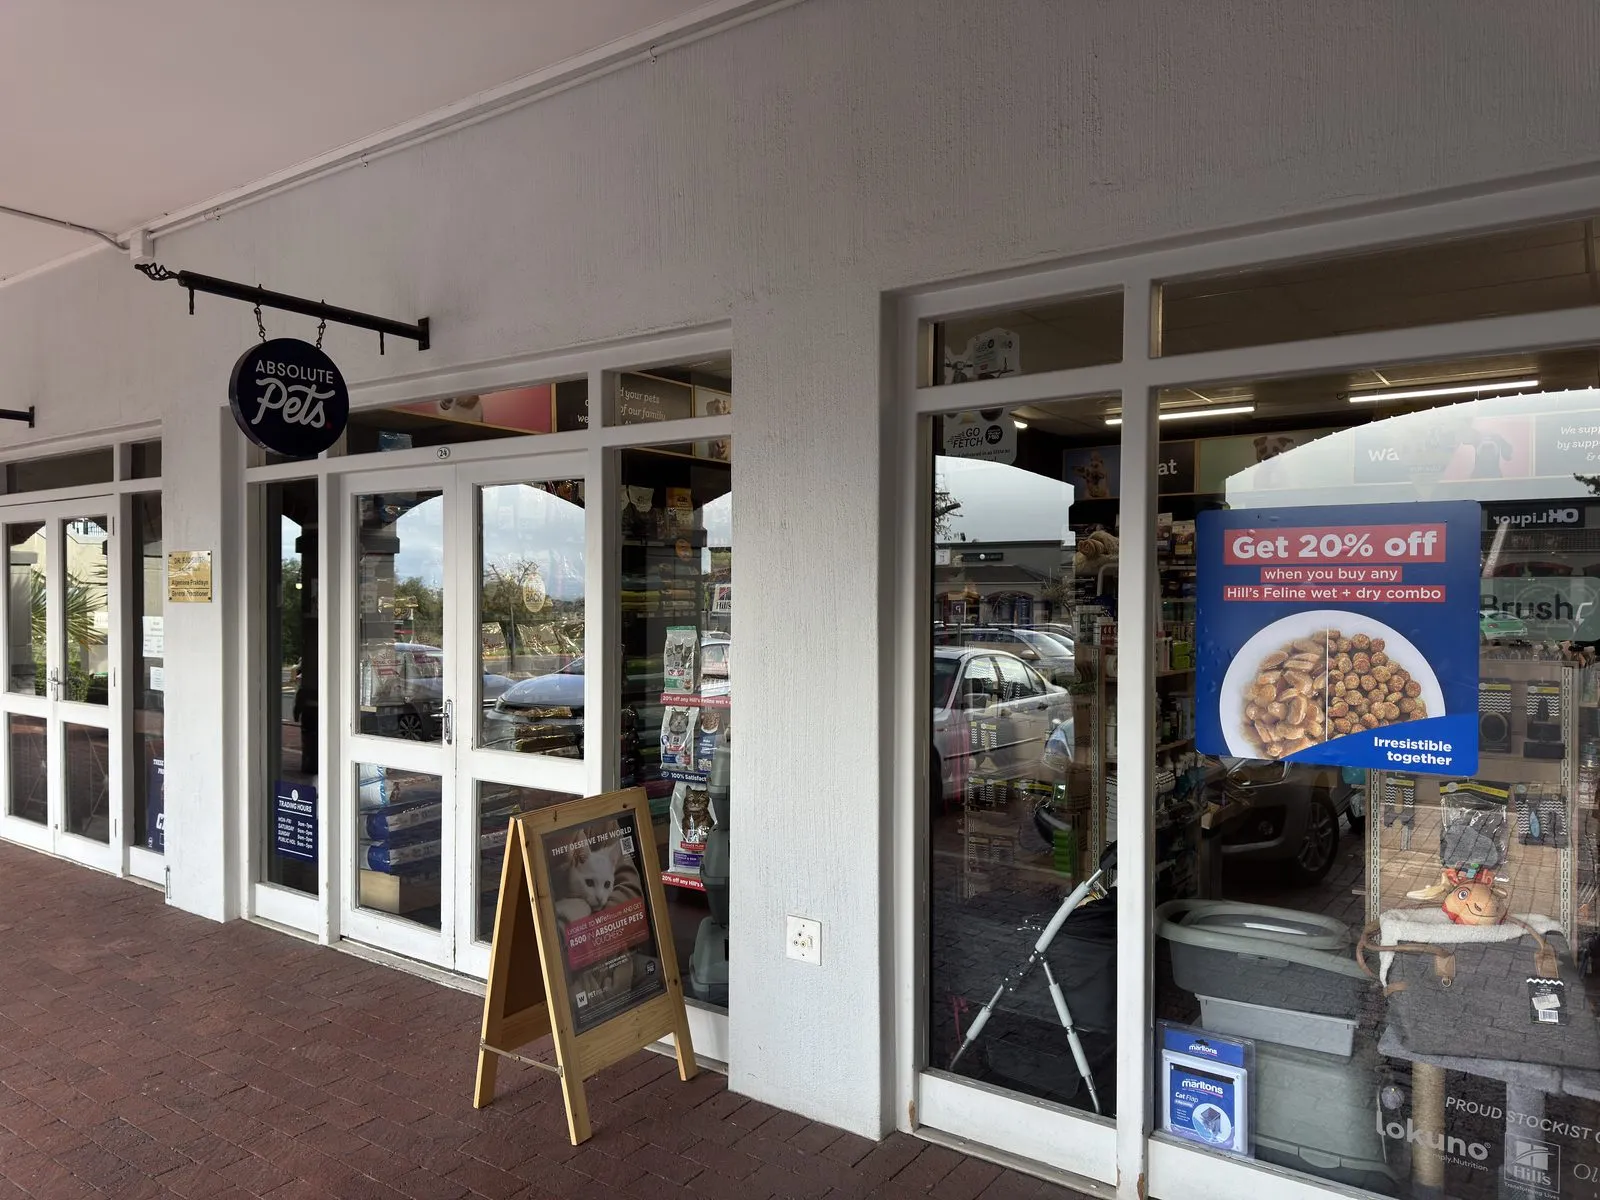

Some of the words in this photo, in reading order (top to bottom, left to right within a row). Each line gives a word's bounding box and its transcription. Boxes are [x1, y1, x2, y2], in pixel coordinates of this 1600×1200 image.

[255, 359, 334, 385] ABSOLUTE
[966, 427, 980, 438] GO
[1560, 424, 1576, 435] We
[952, 436, 984, 449] FETCH
[1557, 440, 1570, 451] by
[1232, 535, 1289, 559] Get
[1298, 533, 1374, 558] 20%
[1384, 530, 1438, 557] off
[1264, 568, 1302, 580] when
[1307, 570, 1334, 583] you
[1338, 568, 1366, 582] buy
[1370, 569, 1398, 582] any
[1227, 587, 1260, 598] Hill's
[1264, 587, 1306, 598] Feline
[1310, 588, 1338, 598] wet
[1342, 589, 1352, 598] +
[1356, 587, 1382, 600] dry
[1386, 586, 1442, 600] combo
[1480, 593, 1574, 620] Brush
[1374, 736, 1452, 752] Irresistible
[1386, 750, 1452, 766] together
[278, 800, 298, 810] TRADING
[298, 804, 312, 813] HOURS
[552, 845, 568, 856] THEY
[569, 836, 596, 850] DESERVE
[596, 832, 608, 842] THE
[608, 826, 632, 838] WORLD
[570, 934, 587, 948] R500
[595, 918, 628, 937] ABSOLUTE
[628, 912, 644, 924] PETS
[1188, 1044, 1218, 1055] marltons
[1182, 1080, 1224, 1095] marltons
[1175, 1091, 1186, 1100] Cat
[1186, 1094, 1199, 1103] Flap
[1445, 1096, 1503, 1119] PROUD
[1506, 1111, 1593, 1140] STOCKIST
[1513, 1165, 1552, 1186] Hill's
